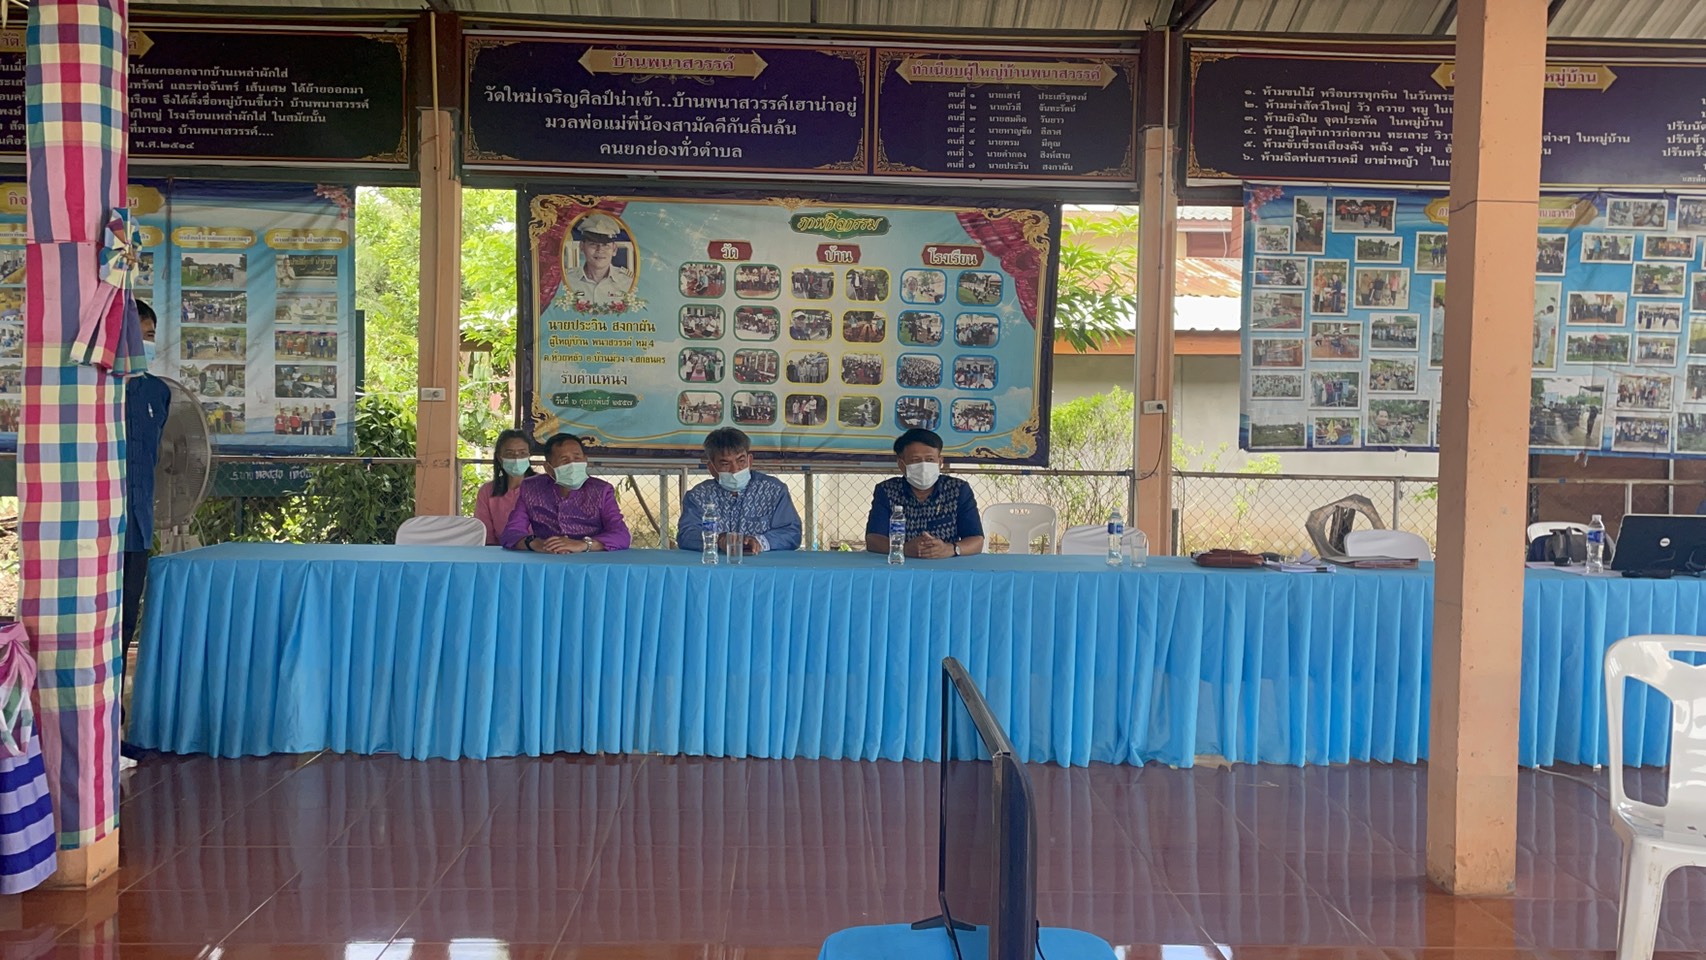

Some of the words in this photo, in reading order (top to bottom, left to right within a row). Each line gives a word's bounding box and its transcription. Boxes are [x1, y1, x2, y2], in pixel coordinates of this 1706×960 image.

[612, 52, 735, 71] บ้านพนาสวรรค์
[128, 64, 288, 78] ได้แยกออกจากบ้านเหล่าผักใส่
[911, 60, 1101, 81] ทำเนียบผู้ใหญ่บ้านพนาสวรรค์
[290, 98, 370, 110] บ้านพนาสวรรค์
[1376, 104, 1405, 113] ควาย
[1389, 115, 1444, 129] ในหมู่บ้าน
[1576, 132, 1631, 146] ในหมู่บ้าน
[600, 136, 743, 158] คนยกย่องทั่วตำบล
[1370, 142, 1393, 152] หลัง
[796, 213, 884, 232] ภาพกิจกรรม
[721, 243, 740, 260] วัด
[824, 245, 853, 263] บ้าน
[928, 247, 979, 266] โรงเรียน
[548, 318, 608, 332] นายประวิน
[549, 335, 589, 348] ผู้ใหญ่บ้าน
[560, 369, 628, 385] รับตำแหน่ง
